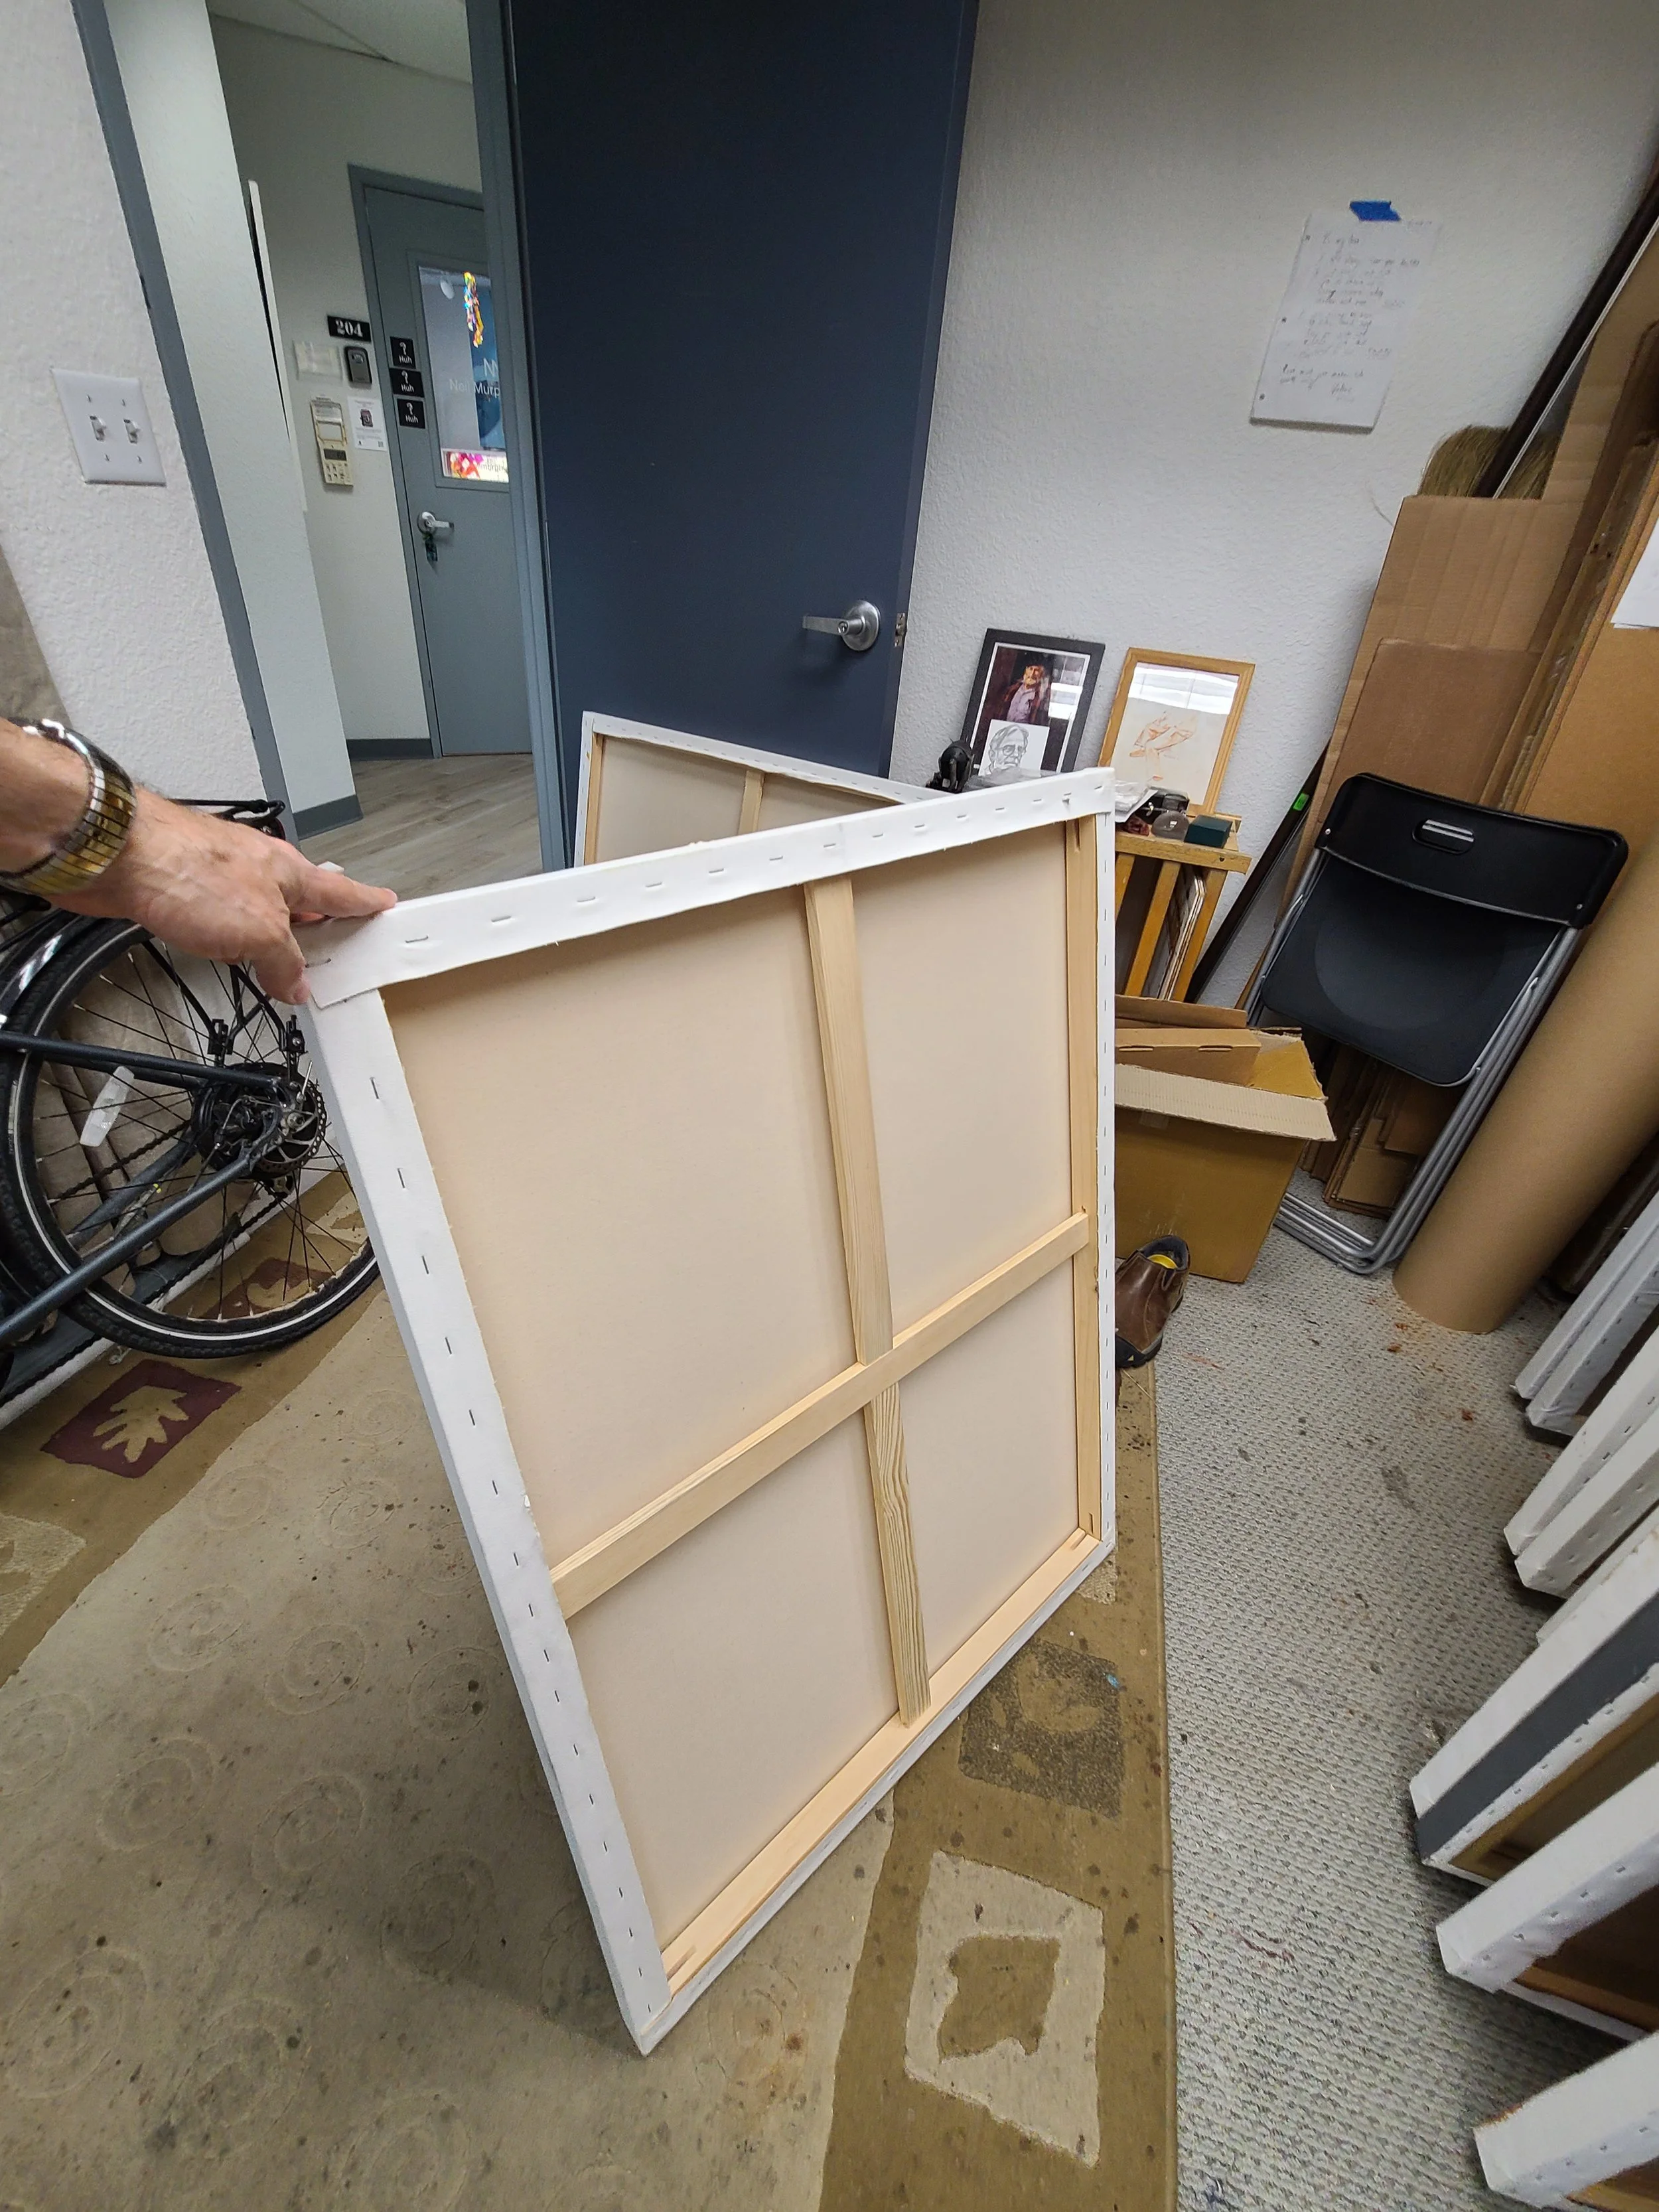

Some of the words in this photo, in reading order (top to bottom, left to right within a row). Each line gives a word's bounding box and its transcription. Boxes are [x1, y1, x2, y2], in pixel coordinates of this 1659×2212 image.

[335, 320, 363, 337] 204
[399, 355, 412, 364] Huh
[401, 384, 414, 392] Huh
[405, 415, 419, 423] Huh
